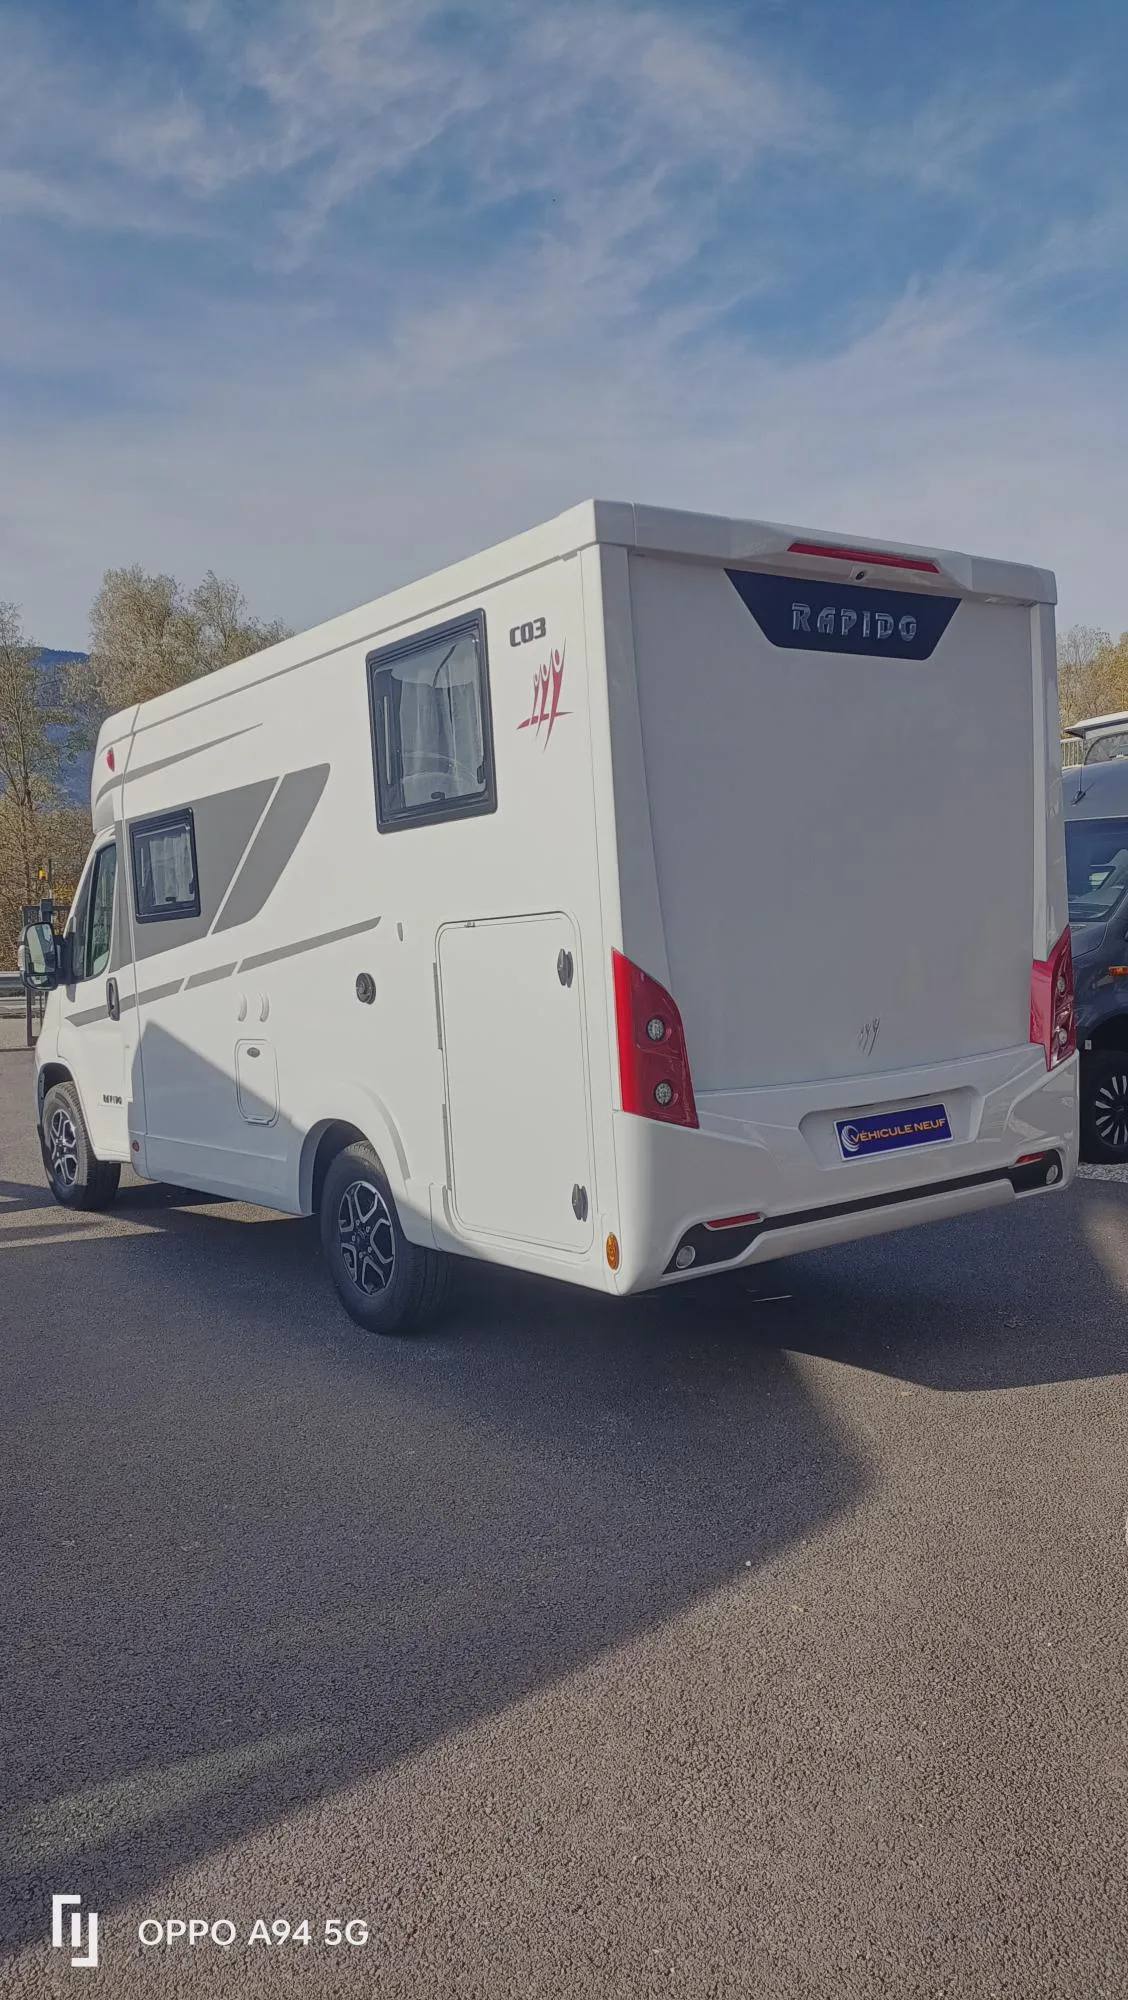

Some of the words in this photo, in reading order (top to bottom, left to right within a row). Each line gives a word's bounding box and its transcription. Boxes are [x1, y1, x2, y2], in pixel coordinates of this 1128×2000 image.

[791, 602, 917, 641] RAPIDO
[851, 1123, 913, 1143] VÉHICULE
[914, 1118, 946, 1132] NEUF
